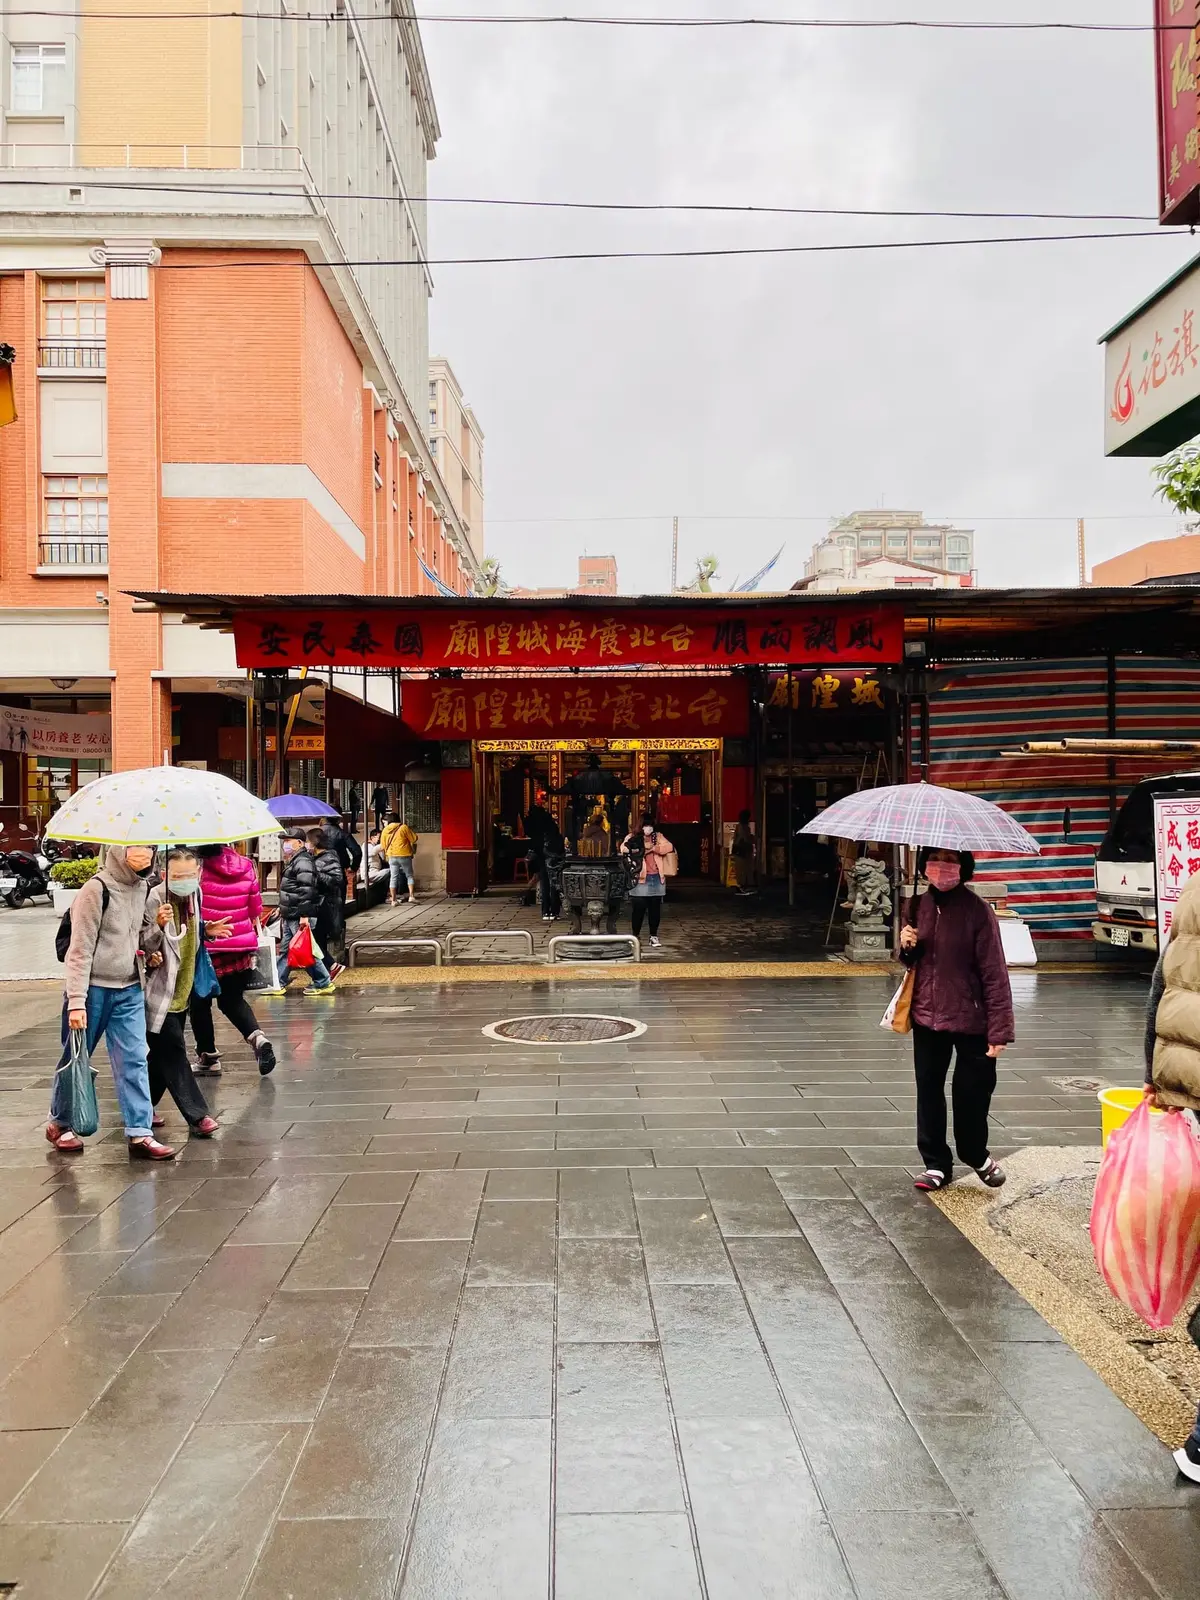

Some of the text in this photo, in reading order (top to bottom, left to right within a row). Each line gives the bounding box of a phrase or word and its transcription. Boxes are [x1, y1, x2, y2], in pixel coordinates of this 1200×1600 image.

[258, 620, 424, 659] 國泰民安
[444, 618, 694, 658] 台北霞海城隍廟
[425, 684, 729, 733] 台北霞海城隍廟
[768, 673, 885, 710] 城隍廟
[32, 729, 110, 744] 以房養老 安心
